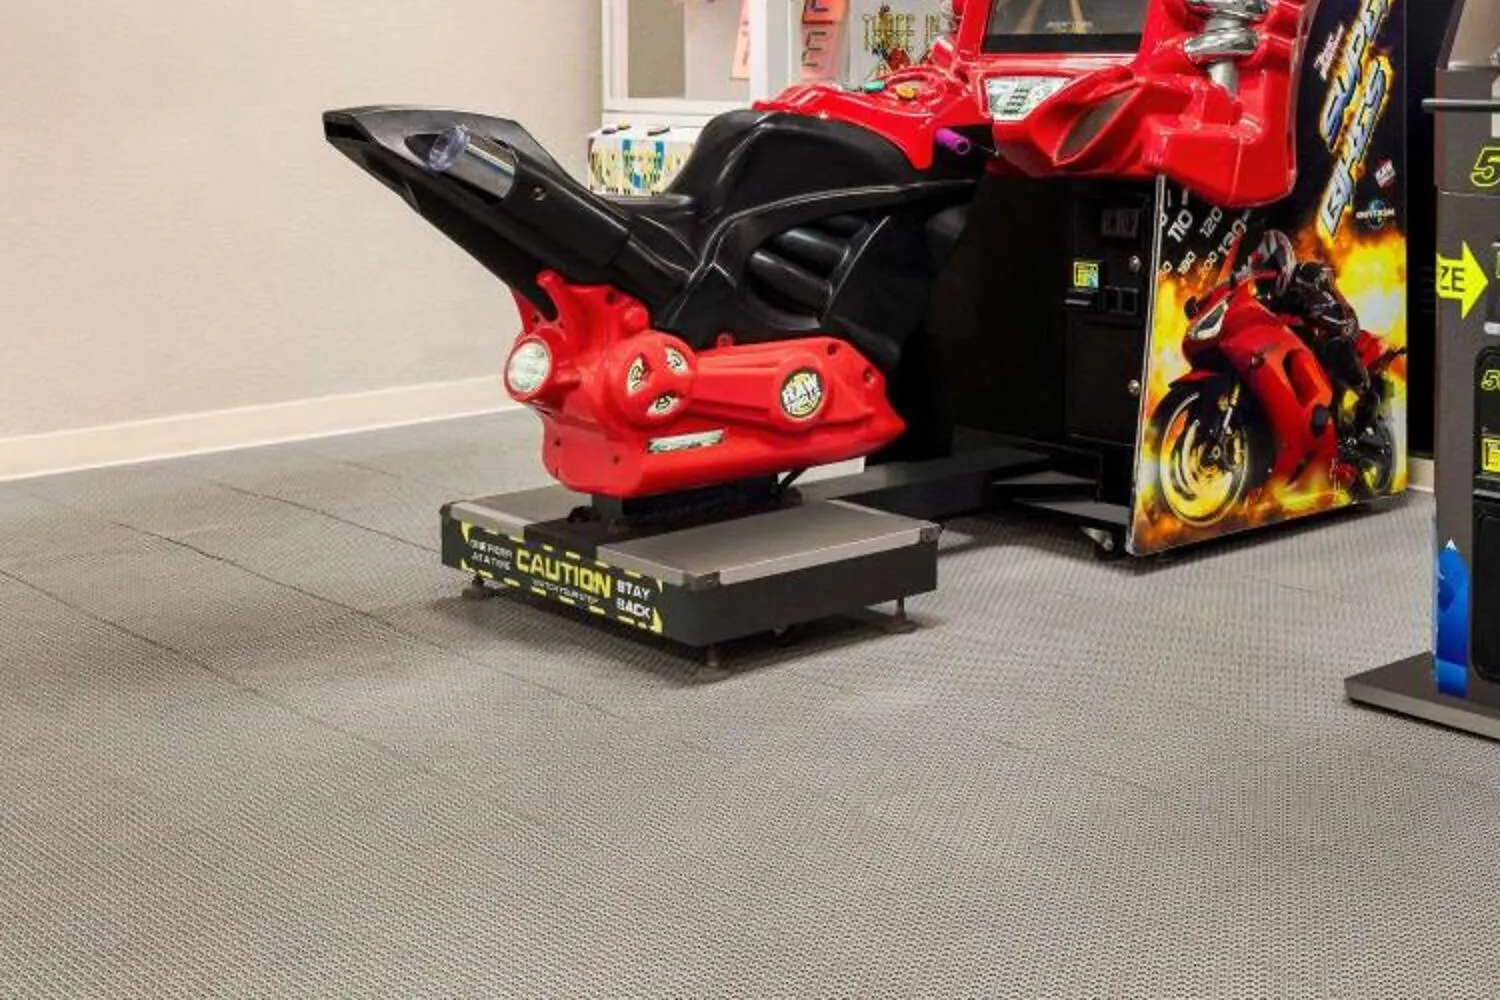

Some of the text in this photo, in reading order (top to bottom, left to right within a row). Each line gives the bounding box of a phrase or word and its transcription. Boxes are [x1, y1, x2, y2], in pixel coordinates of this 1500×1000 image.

[1167, 209, 1194, 243] 110
[1199, 206, 1223, 238] 120
[516, 548, 612, 599] CAUTION
[616, 579, 651, 600] STAY
[616, 597, 651, 619] BACK
